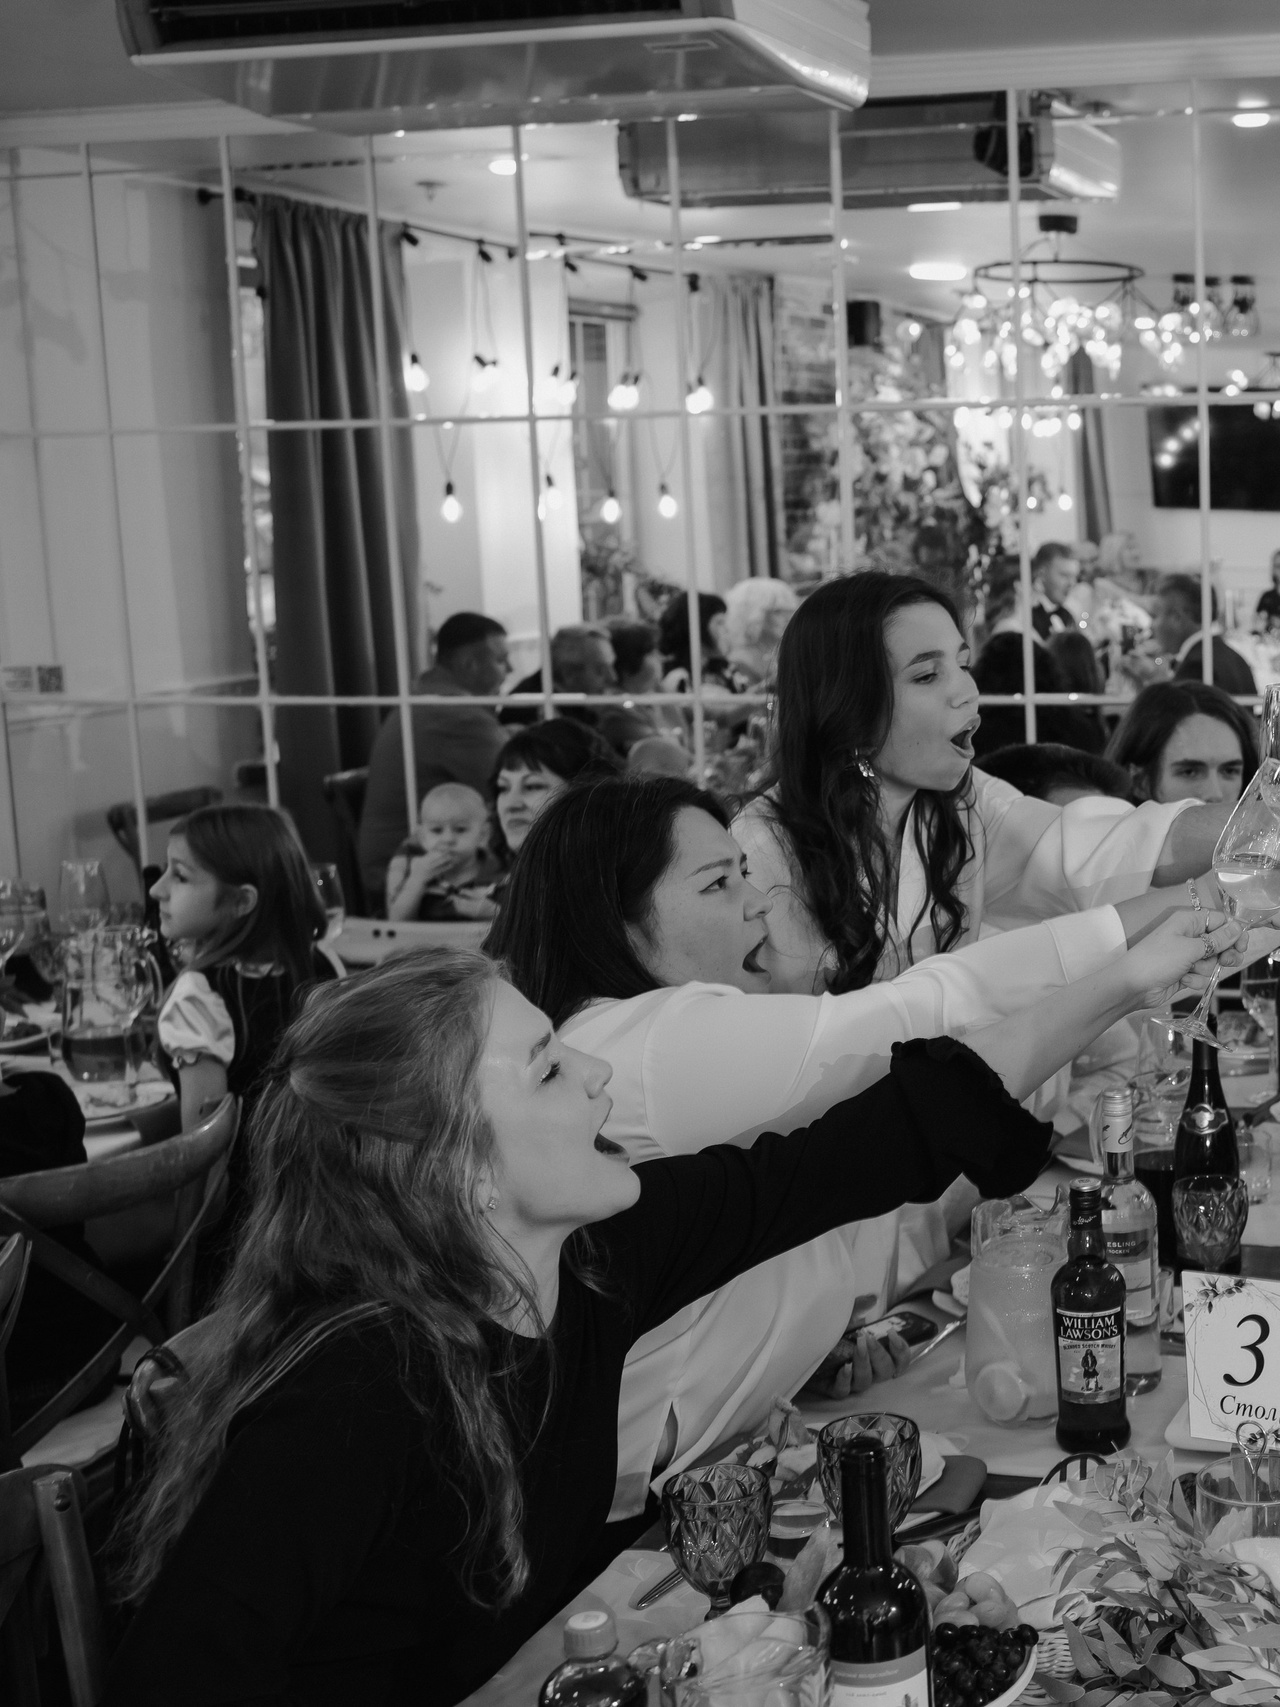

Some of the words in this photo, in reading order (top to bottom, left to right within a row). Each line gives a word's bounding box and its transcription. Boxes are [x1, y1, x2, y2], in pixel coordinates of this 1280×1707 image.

[1106, 1240, 1136, 1248] ESLING
[1062, 1315, 1115, 1329] WILLIAM
[1060, 1325, 1118, 1340] LAWSON'S
[1223, 1314, 1270, 1387] 3
[1220, 1395, 1277, 1421] Стол
